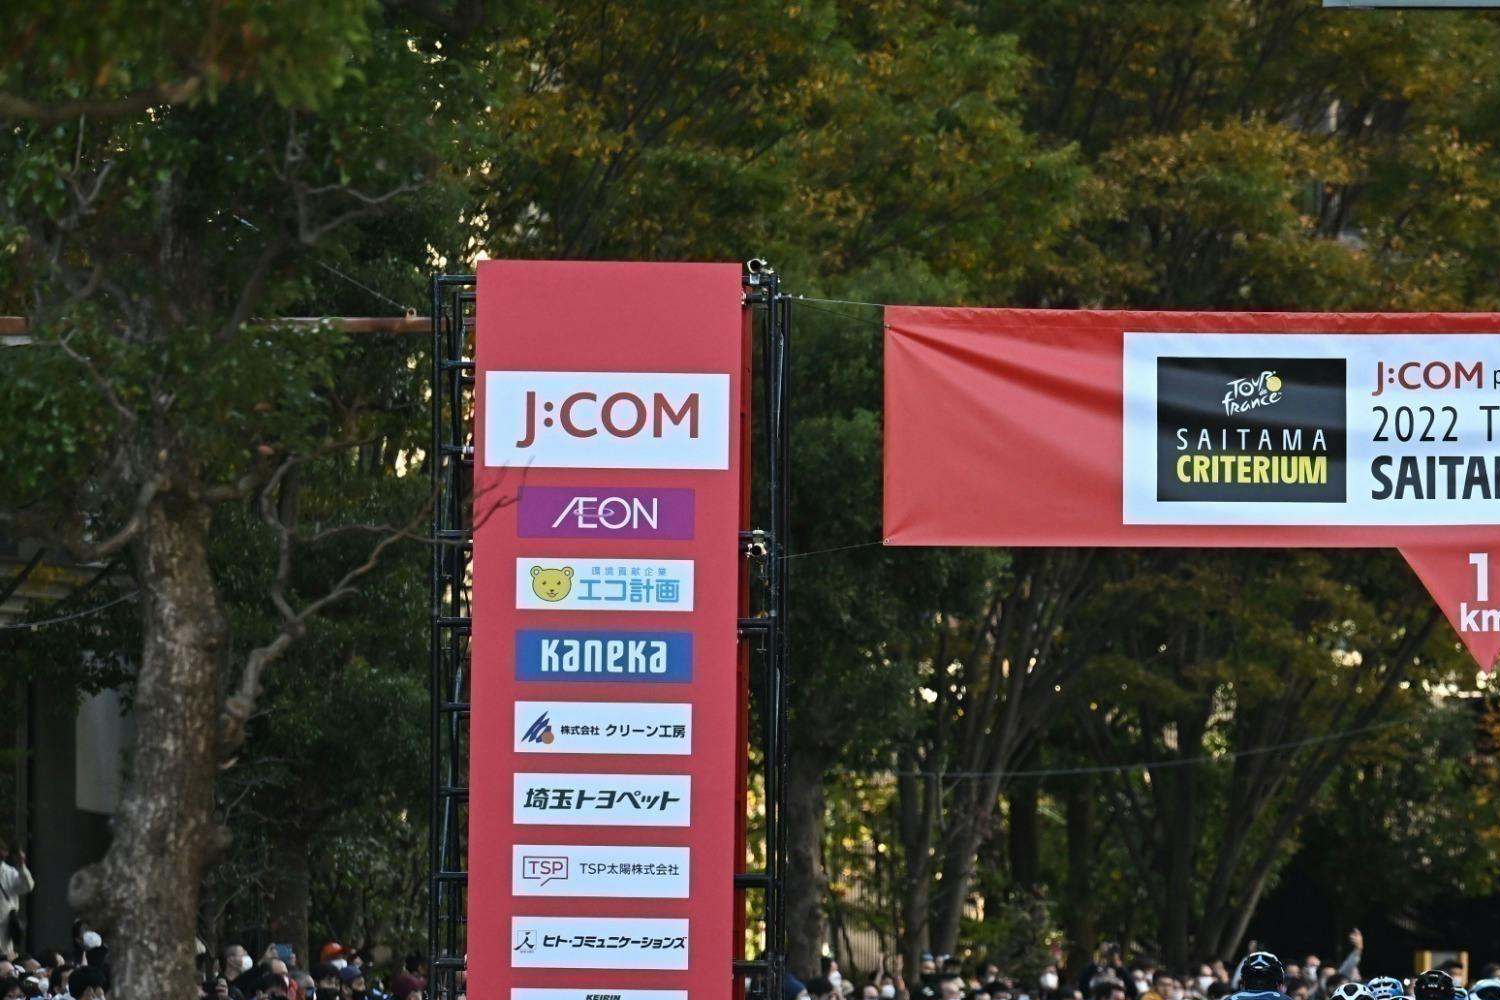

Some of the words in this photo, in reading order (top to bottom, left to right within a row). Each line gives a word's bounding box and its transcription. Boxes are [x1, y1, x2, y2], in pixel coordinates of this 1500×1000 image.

[1372, 361, 1483, 396] J:COM
[516, 391, 699, 448] J:COM
[1373, 406, 1458, 442] 2022
[1176, 428, 1327, 451] SAITAMA
[1176, 455, 1327, 484] CRITERIUM
[1468, 553, 1489, 602] 1
[578, 579, 680, 603] エコ計画
[561, 725, 600, 736] 株式会社
[606, 724, 686, 738] クリーン工房
[524, 788, 680, 811] 埼玉トヨペット
[529, 860, 563, 875] TSP
[580, 863, 680, 876] TSP太陽株式会社
